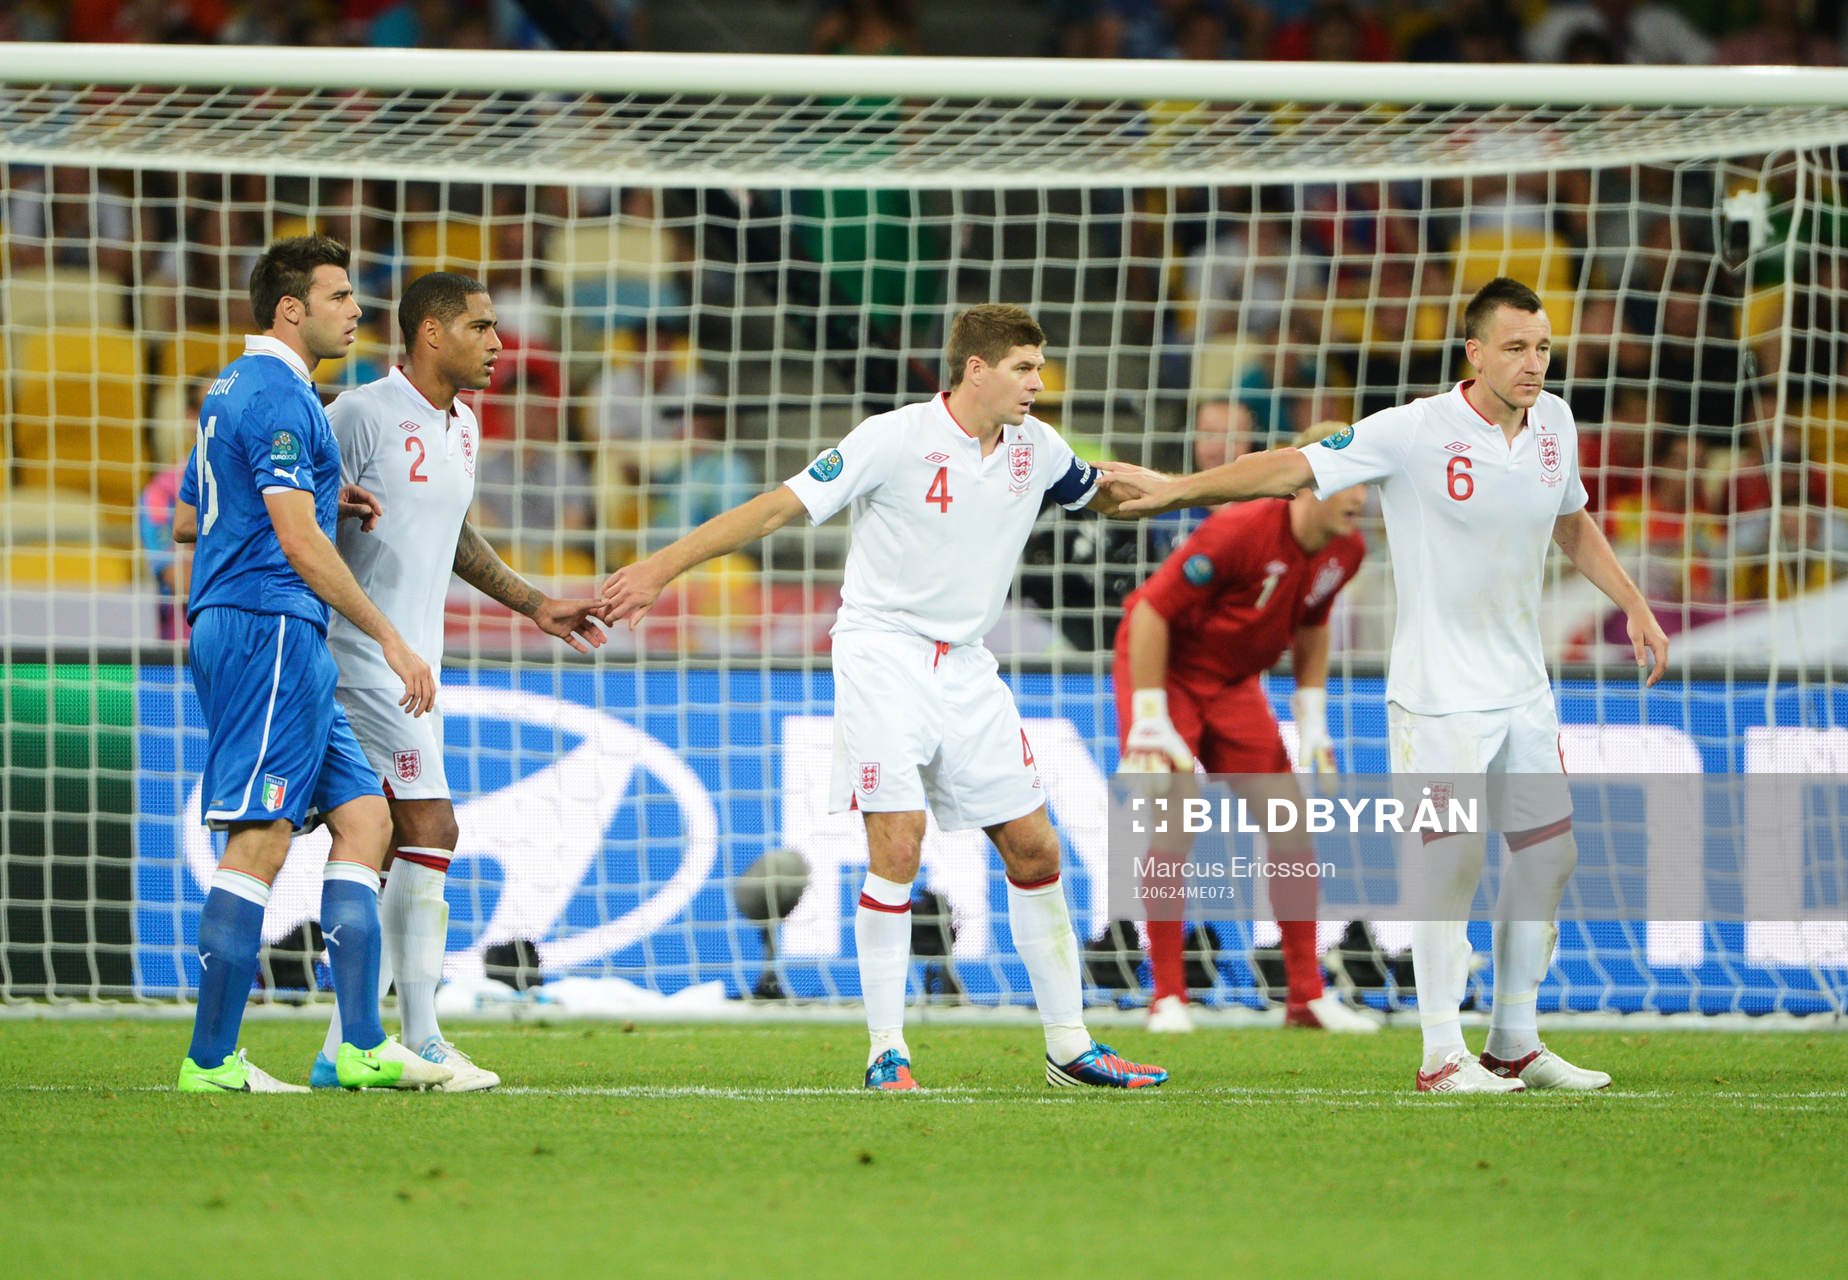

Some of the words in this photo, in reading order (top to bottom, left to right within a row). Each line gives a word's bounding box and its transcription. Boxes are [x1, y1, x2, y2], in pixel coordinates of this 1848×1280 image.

[404, 436, 428, 482] 2
[1446, 455, 1474, 502] 6
[925, 466, 953, 513] 4
[1254, 574, 1279, 610] 1
